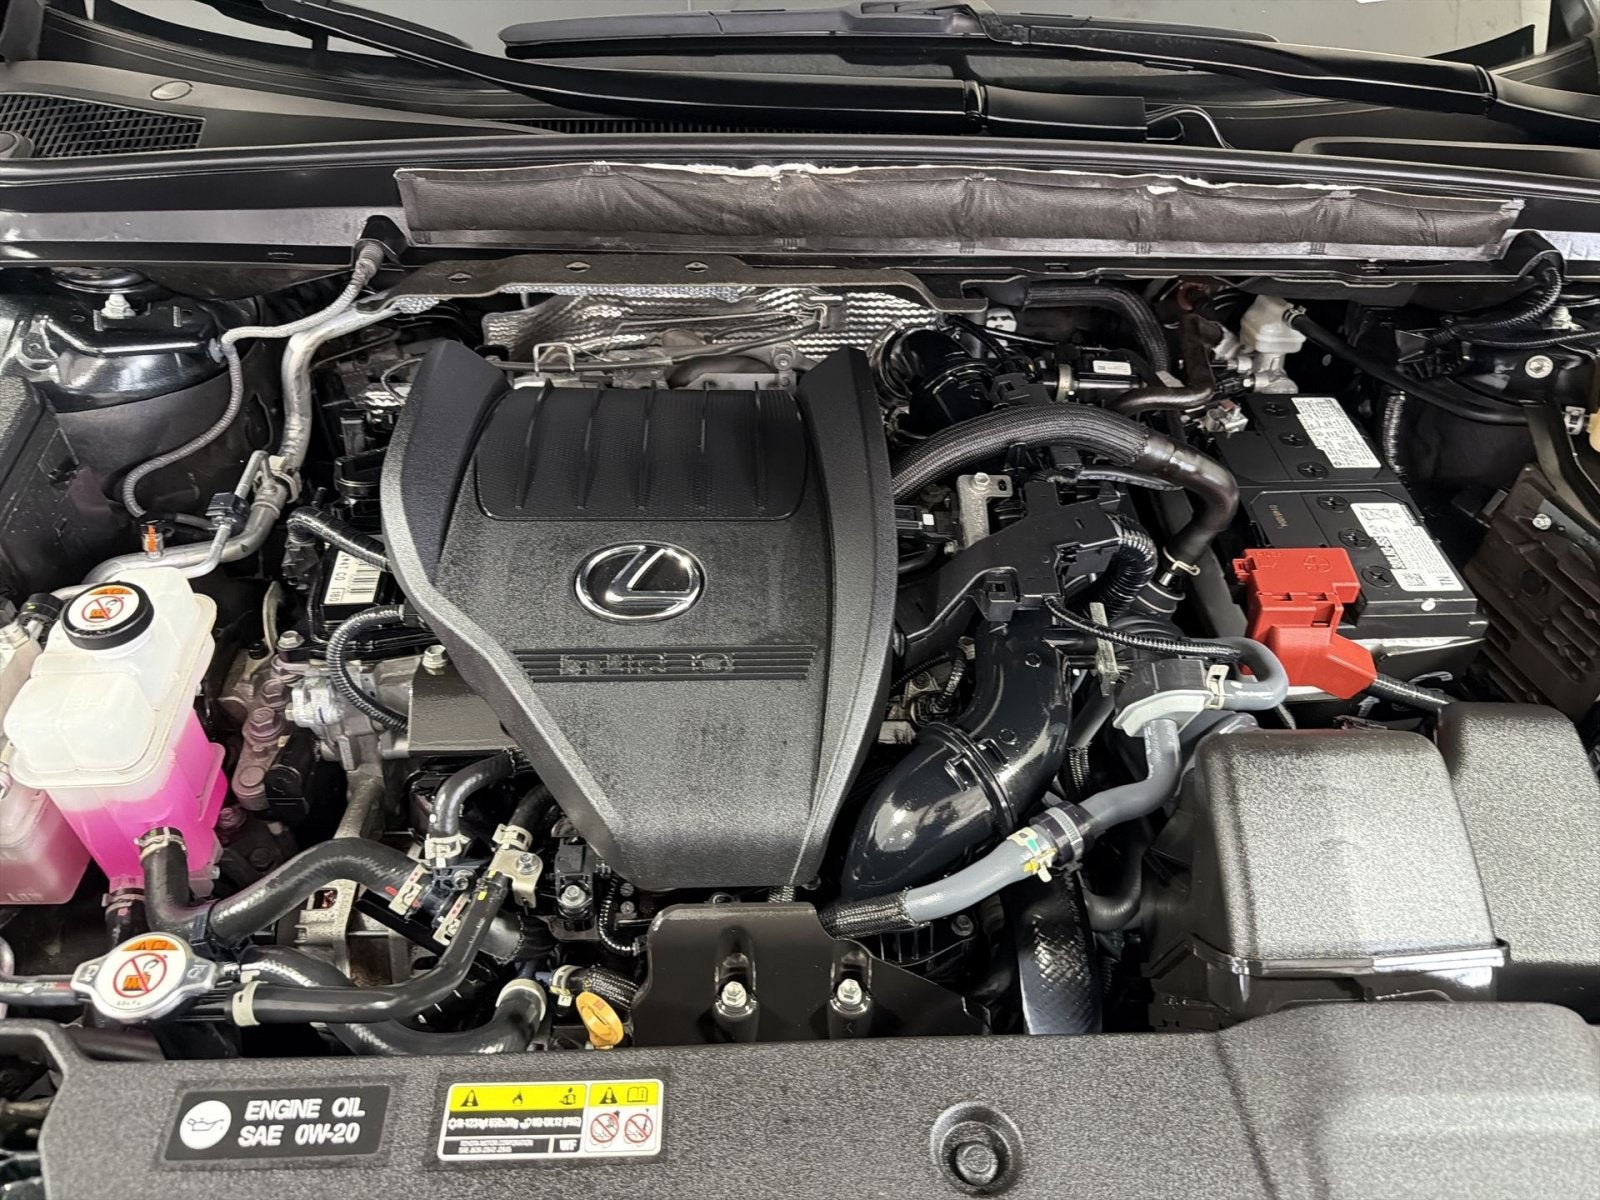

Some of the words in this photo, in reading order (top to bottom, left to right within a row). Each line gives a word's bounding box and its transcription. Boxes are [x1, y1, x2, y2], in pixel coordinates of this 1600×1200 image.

[244, 1098, 323, 1121] ENGINE
[331, 1097, 366, 1118] OIL
[237, 1124, 285, 1147] SAE
[294, 1122, 361, 1146] 0W-20
